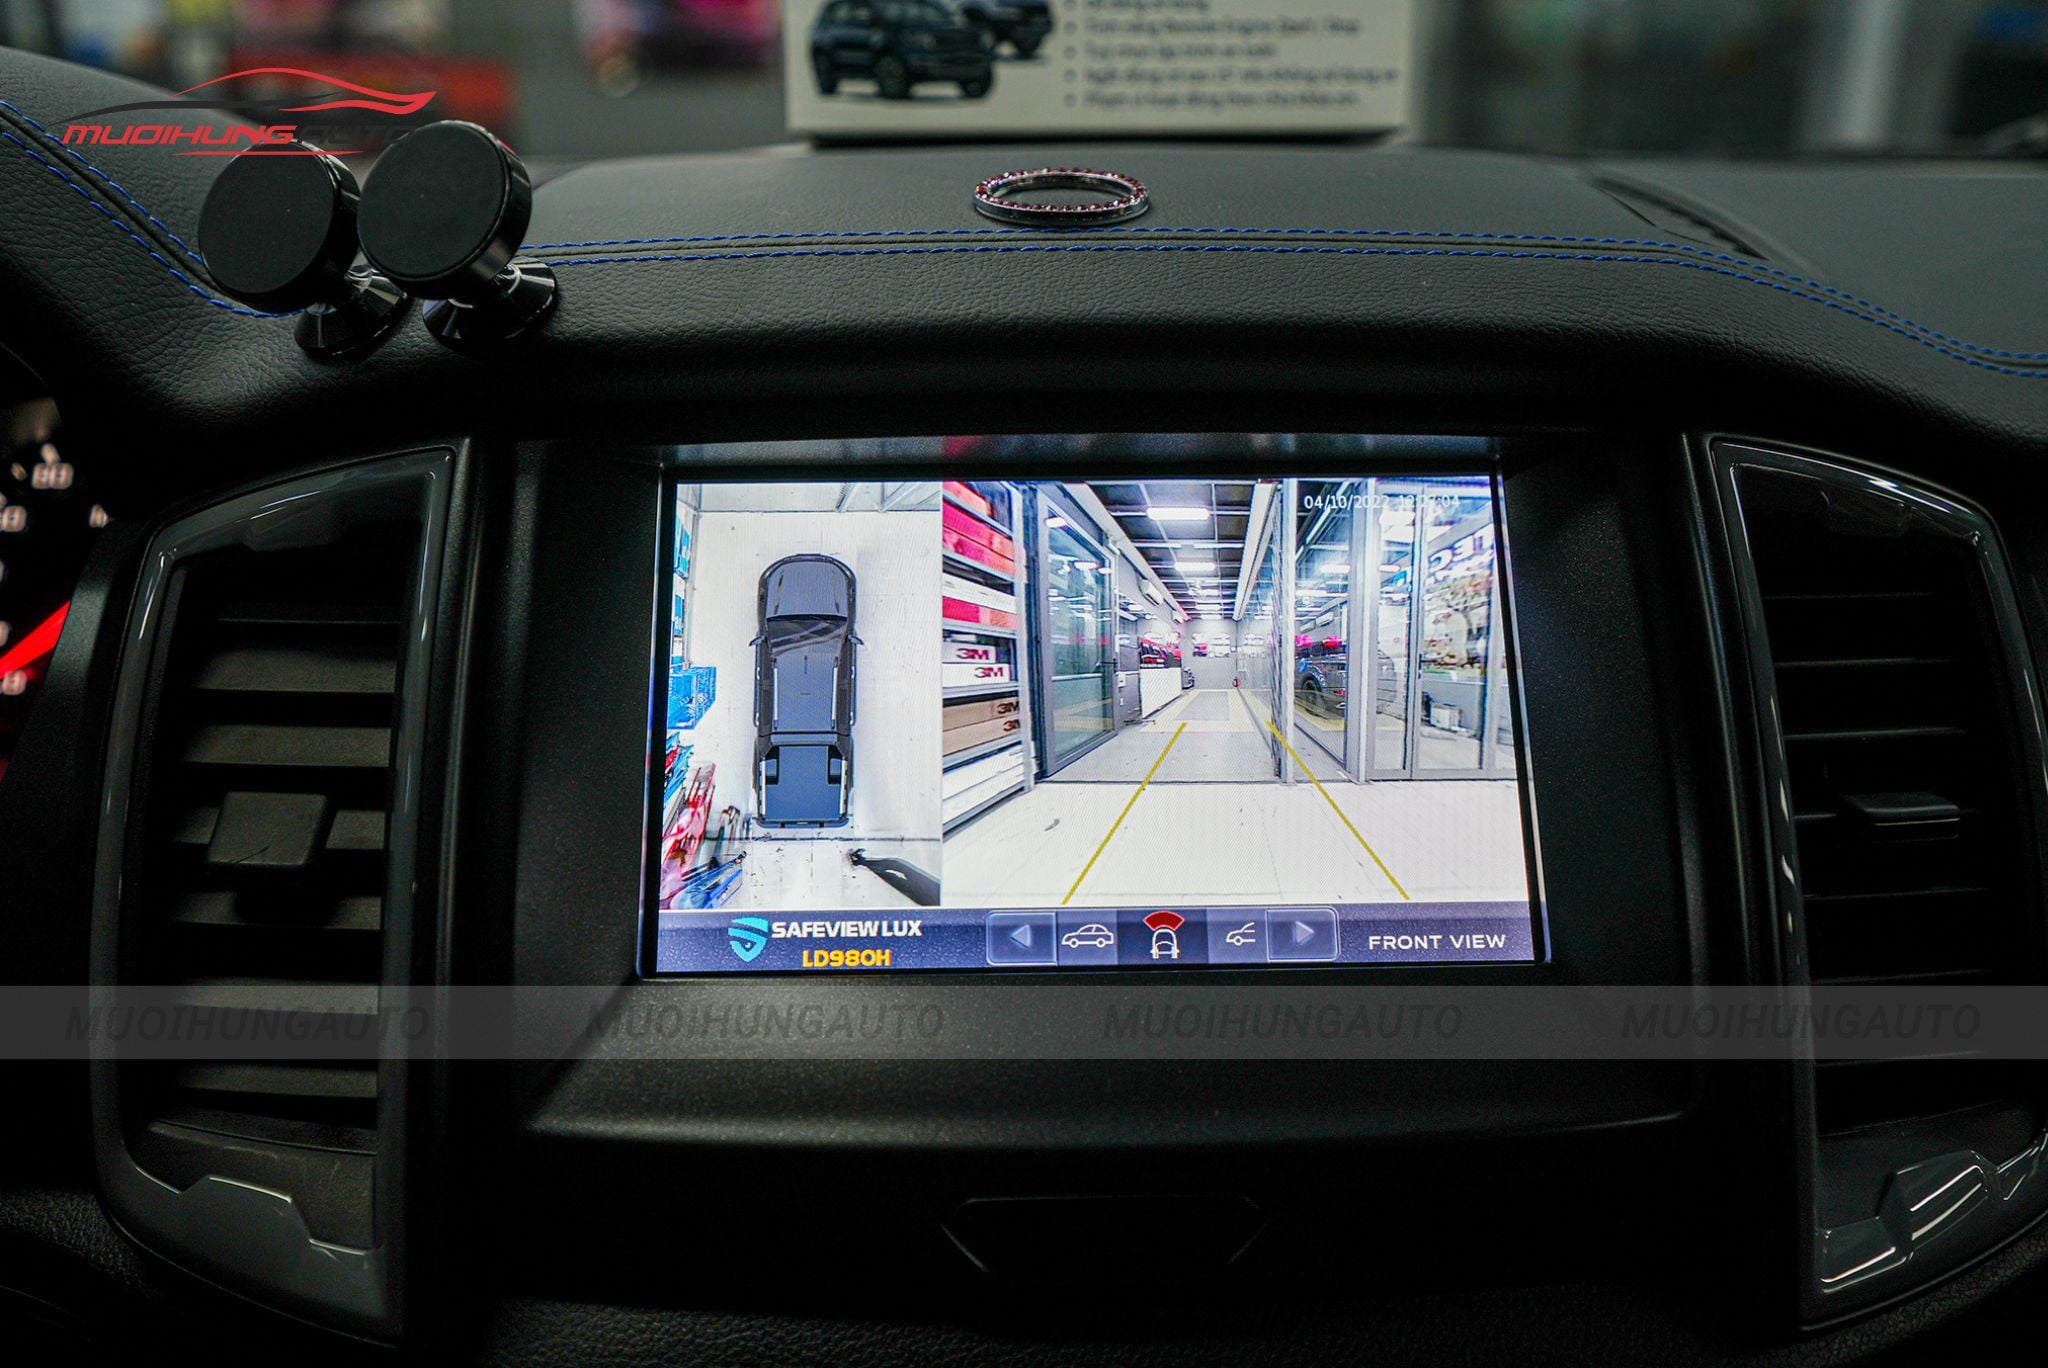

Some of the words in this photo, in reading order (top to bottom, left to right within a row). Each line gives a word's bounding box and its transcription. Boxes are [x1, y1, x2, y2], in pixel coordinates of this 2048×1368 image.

[1303, 495, 1390, 510] 04/10/2022
[956, 648, 989, 660] 3M
[974, 667, 1003, 678] 3M
[881, 920, 922, 937] LUX
[1368, 934, 1443, 951] FRONT
[1450, 933, 1507, 950] VIEW
